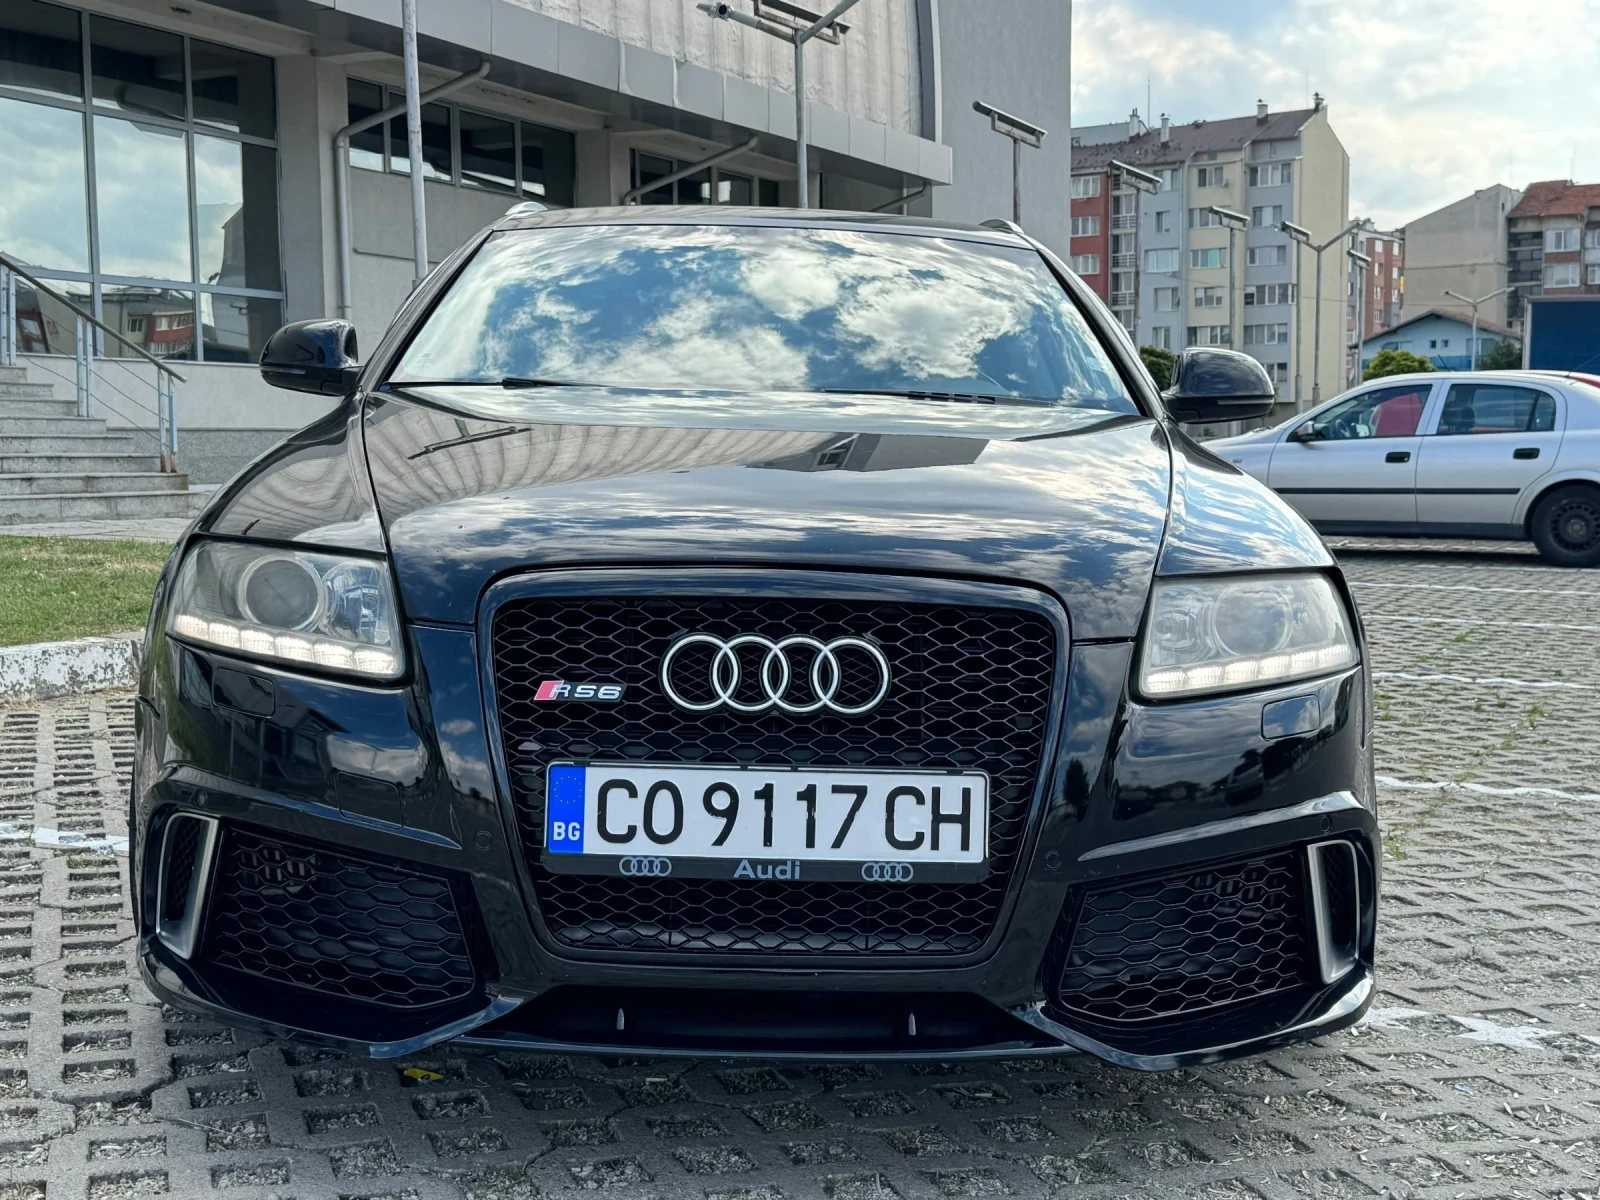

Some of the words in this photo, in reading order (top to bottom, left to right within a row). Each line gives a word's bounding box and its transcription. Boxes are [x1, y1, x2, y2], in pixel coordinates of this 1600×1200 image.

[549, 684, 622, 699] RS6
[702, 781, 868, 849] 9117
[884, 785, 971, 852] CH
[553, 821, 580, 841] BG
[733, 859, 800, 880] Audi
